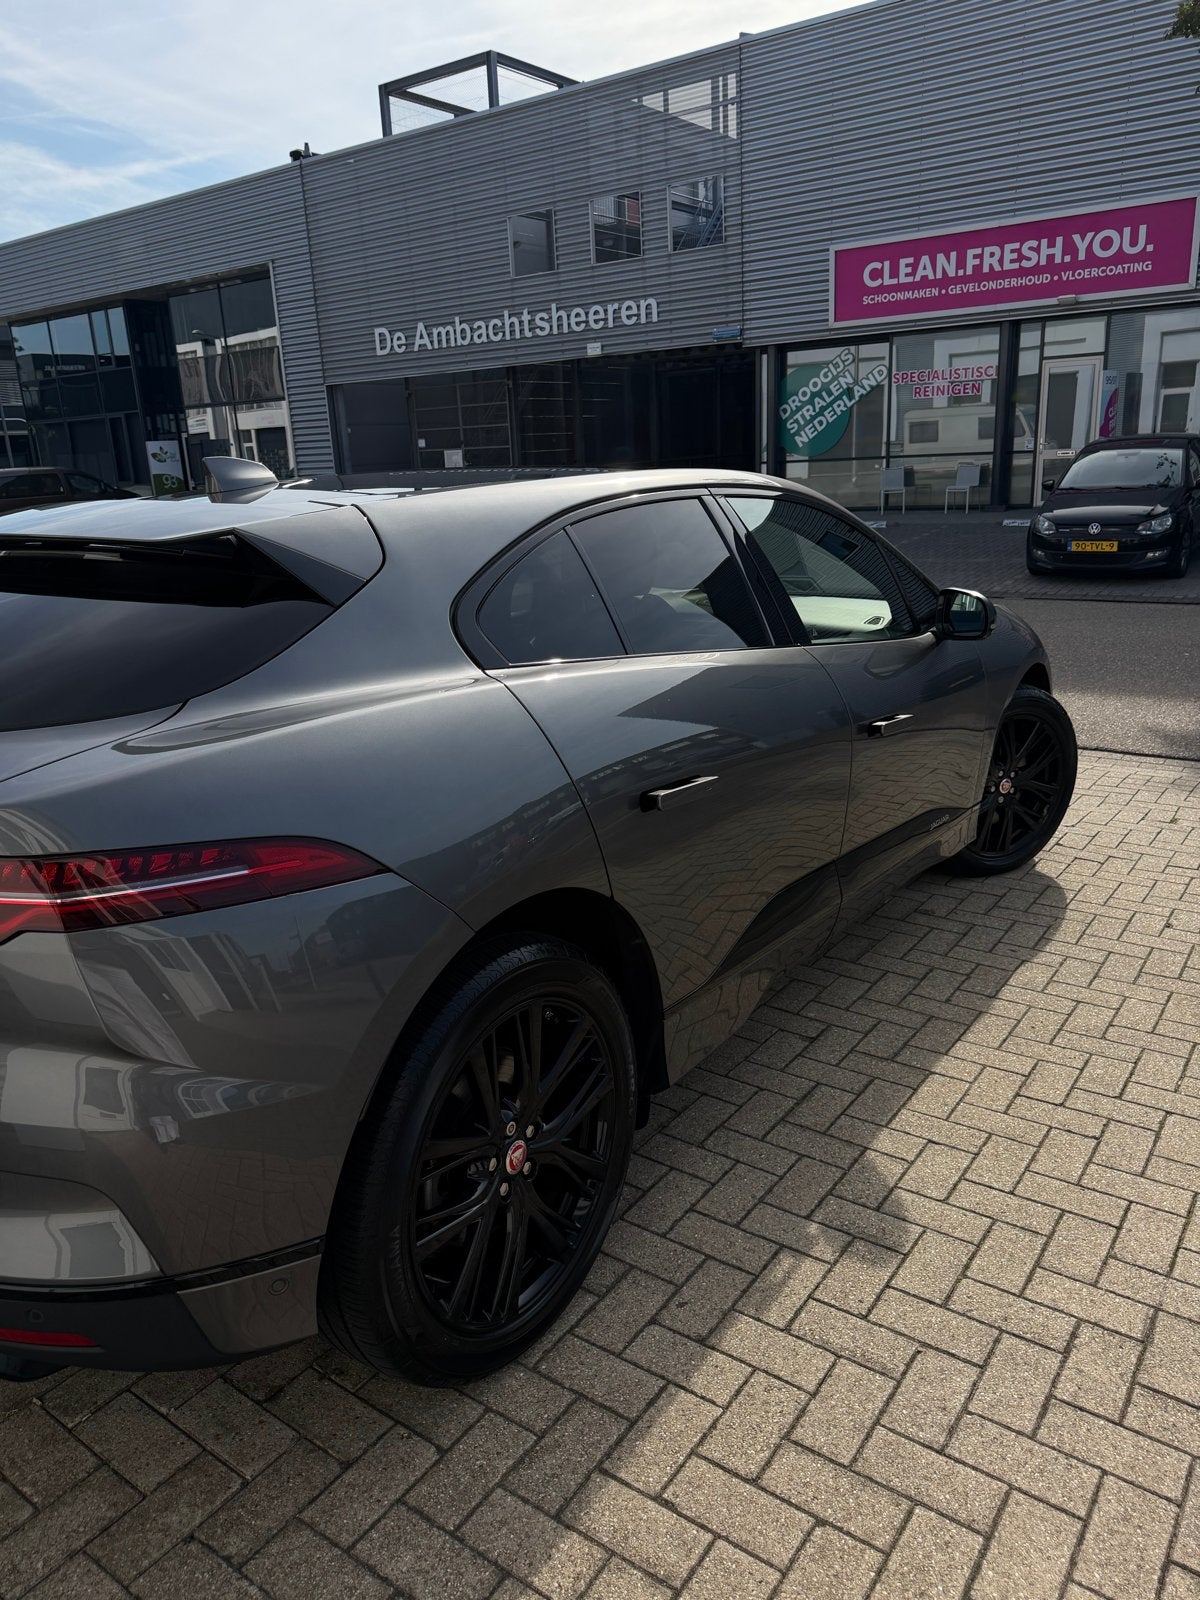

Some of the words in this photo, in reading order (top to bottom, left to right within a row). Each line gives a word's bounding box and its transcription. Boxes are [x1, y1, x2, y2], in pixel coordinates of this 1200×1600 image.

[862, 224, 1154, 287] CLEAN.FRESH.YOU.
[862, 287, 939, 305] SCHOONMAKEN
[948, 273, 1051, 295] GEVELONDERHOUD
[1061, 261, 1153, 281] VLOERCOATING
[374, 327, 408, 356] De
[413, 296, 659, 352] Ambachtsheeren
[778, 348, 855, 420] DROOGIJS
[786, 371, 855, 433] STRALEN
[794, 365, 888, 448] NEDERLAND
[913, 382, 982, 399] REINIGEN
[162, 474, 178, 489] 93
[1074, 542, 1115, 551] 90-TVL-9
